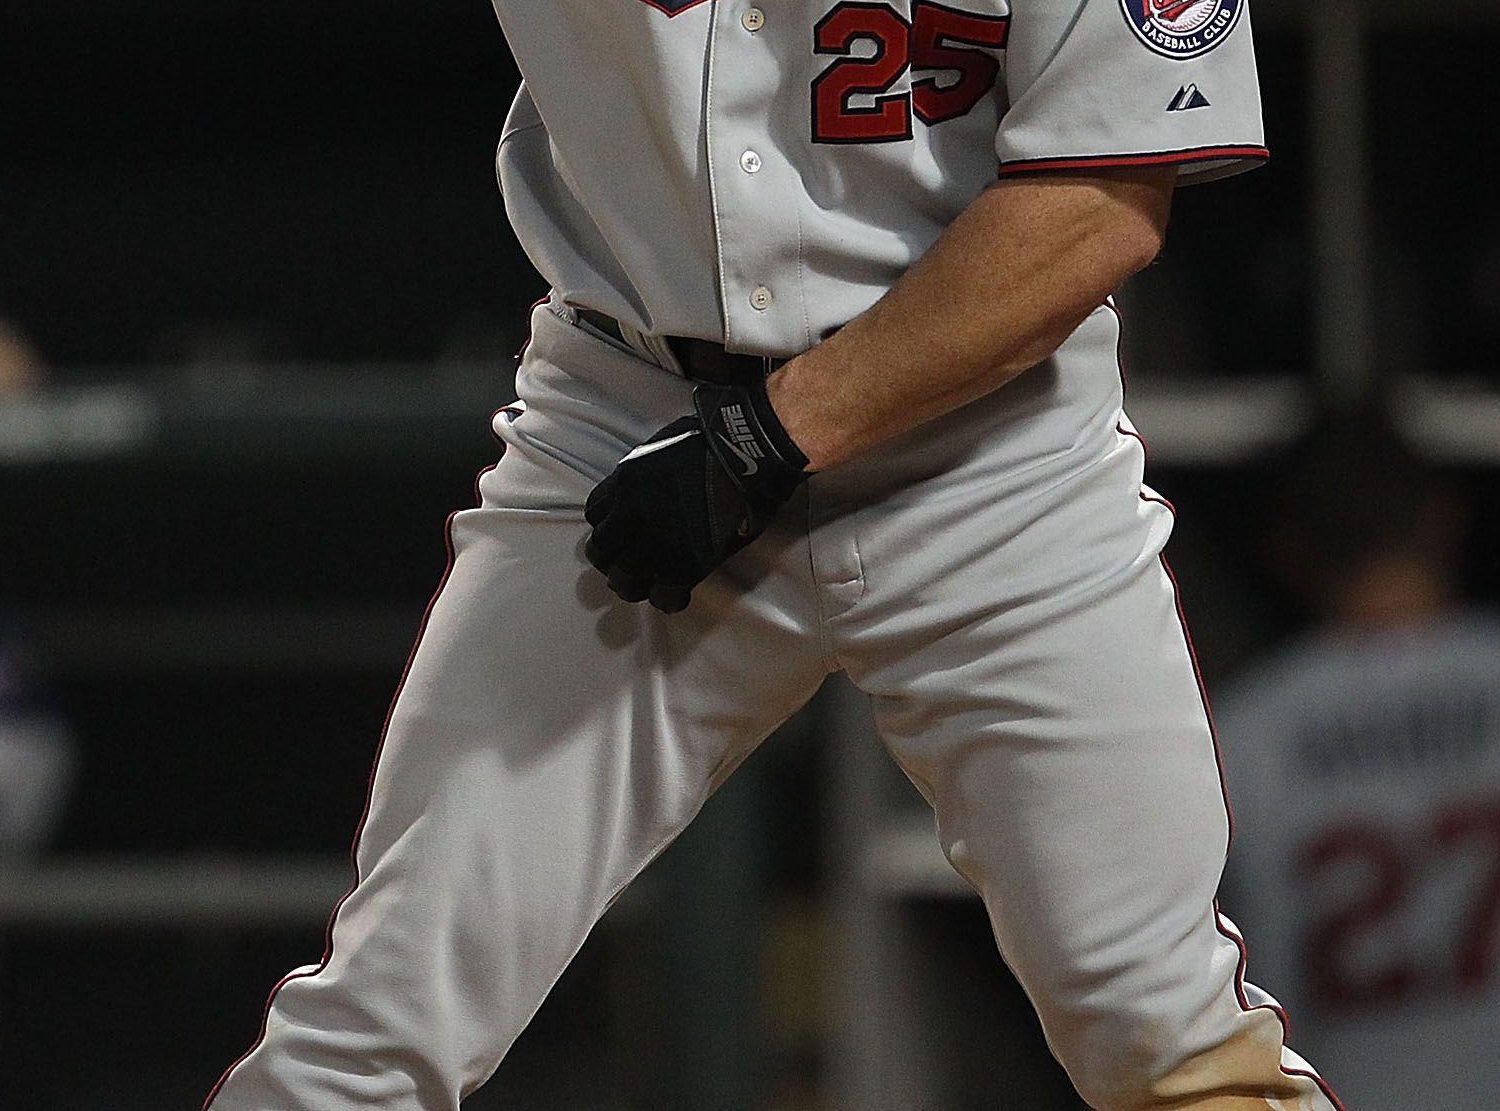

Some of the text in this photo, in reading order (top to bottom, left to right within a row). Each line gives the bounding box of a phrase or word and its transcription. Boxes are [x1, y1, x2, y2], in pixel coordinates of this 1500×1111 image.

[1142, 7, 1231, 50] BASEBALL CLUB
[726, 404, 765, 458] ELITE
